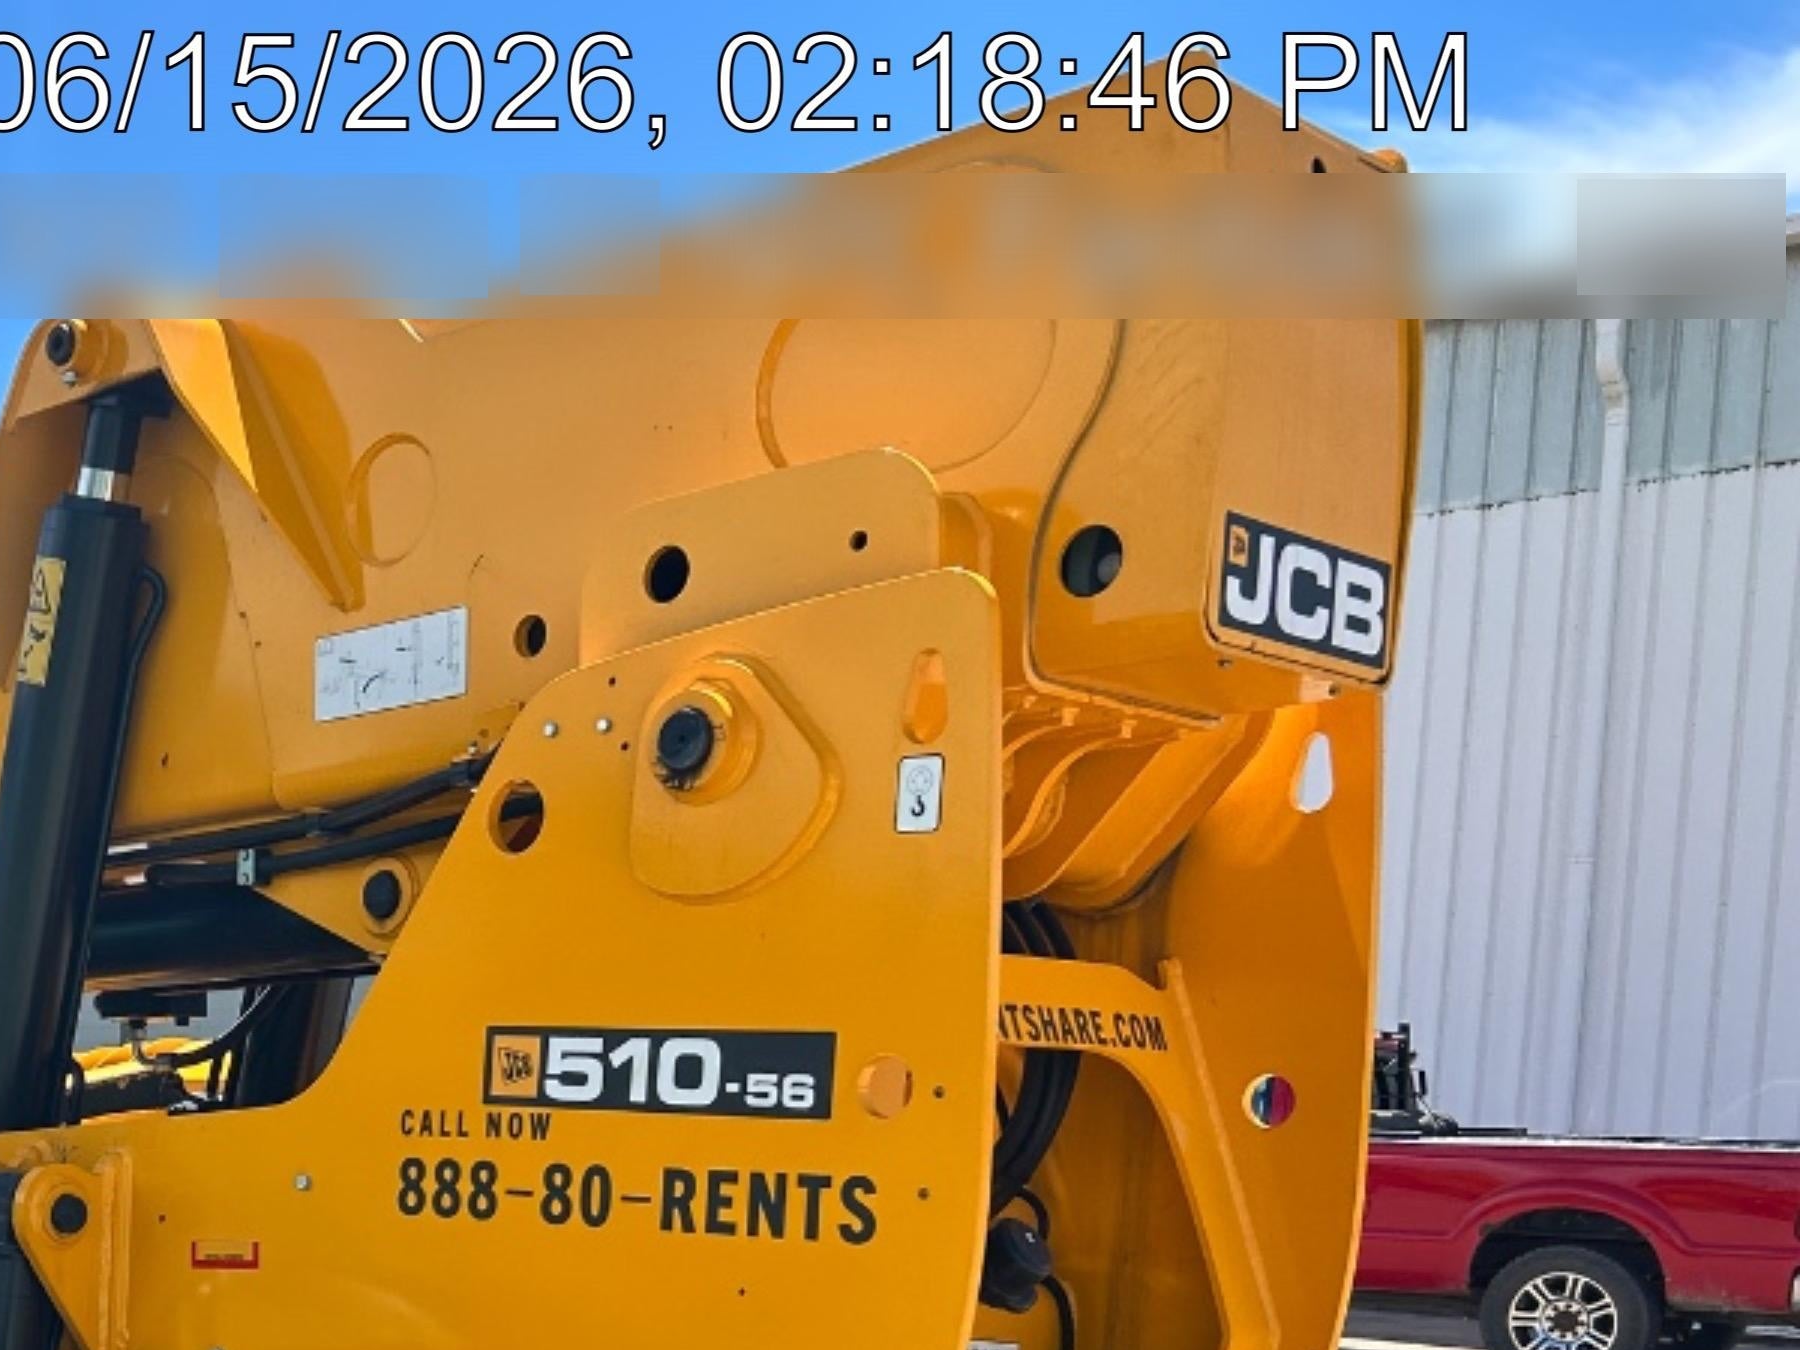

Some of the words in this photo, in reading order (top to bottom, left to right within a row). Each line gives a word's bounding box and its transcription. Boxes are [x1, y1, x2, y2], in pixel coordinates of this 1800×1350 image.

[1226, 533, 1385, 656] JCB
[543, 1036, 817, 1109] 510-56
[401, 1109, 469, 1137] CALL
[485, 1112, 552, 1141] NOW
[398, 1157, 878, 1245] 888-80-RENTS
